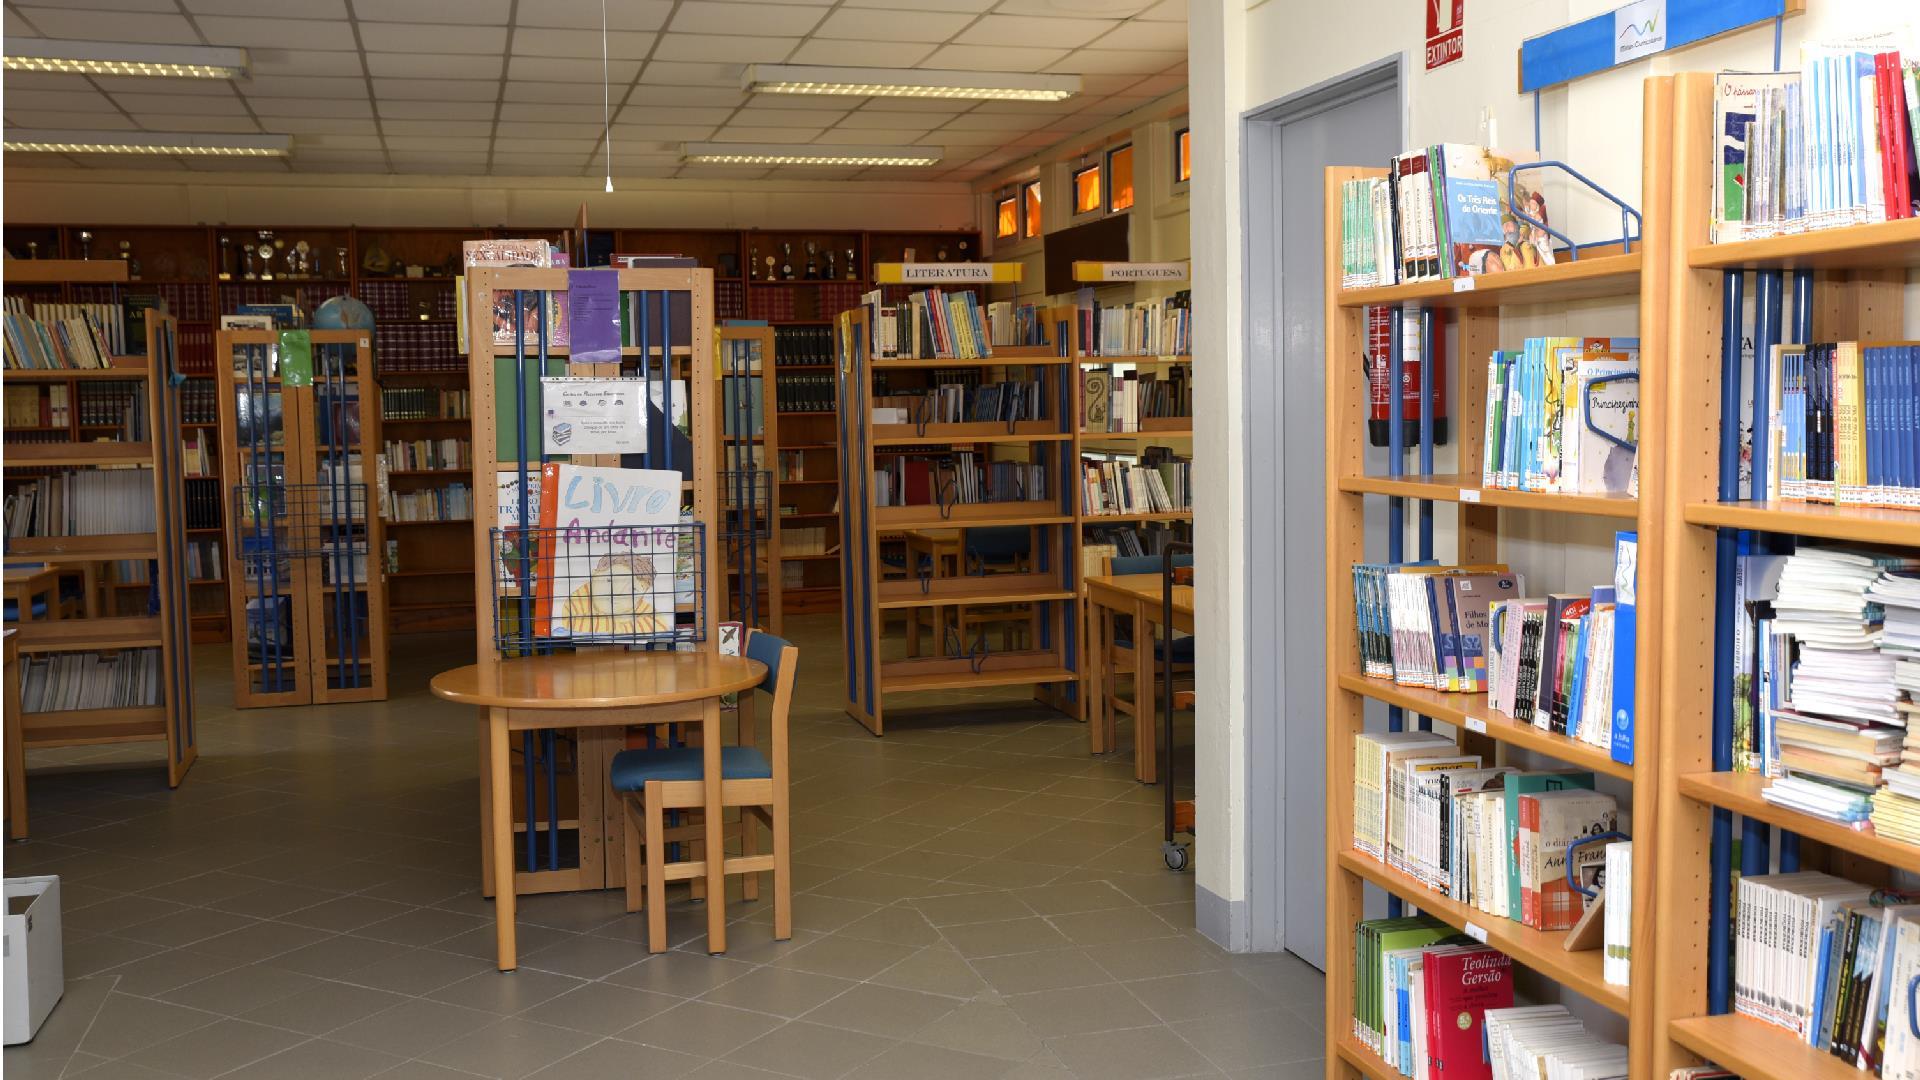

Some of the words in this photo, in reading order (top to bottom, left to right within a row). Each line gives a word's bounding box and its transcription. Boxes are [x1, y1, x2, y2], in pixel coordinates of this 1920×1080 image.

[1426, 36, 1463, 64] EXTINTOR
[1457, 193, 1467, 203] Os
[1468, 194, 1482, 205] Três
[1482, 196, 1497, 205] Reis
[1472, 205, 1498, 215] Oriente
[906, 268, 988, 278] LITERATURA
[1111, 269, 1182, 277] PORTUGUESA
[564, 475, 672, 514] Livro
[562, 517, 677, 549] Andante
[1464, 610, 1487, 619] Filhos
[1465, 621, 1475, 629] de
[1544, 856, 1568, 869] Ann
[1578, 849, 1606, 863] Fran
[1462, 954, 1512, 971] Teolinda
[1461, 970, 1501, 985] Gersão
